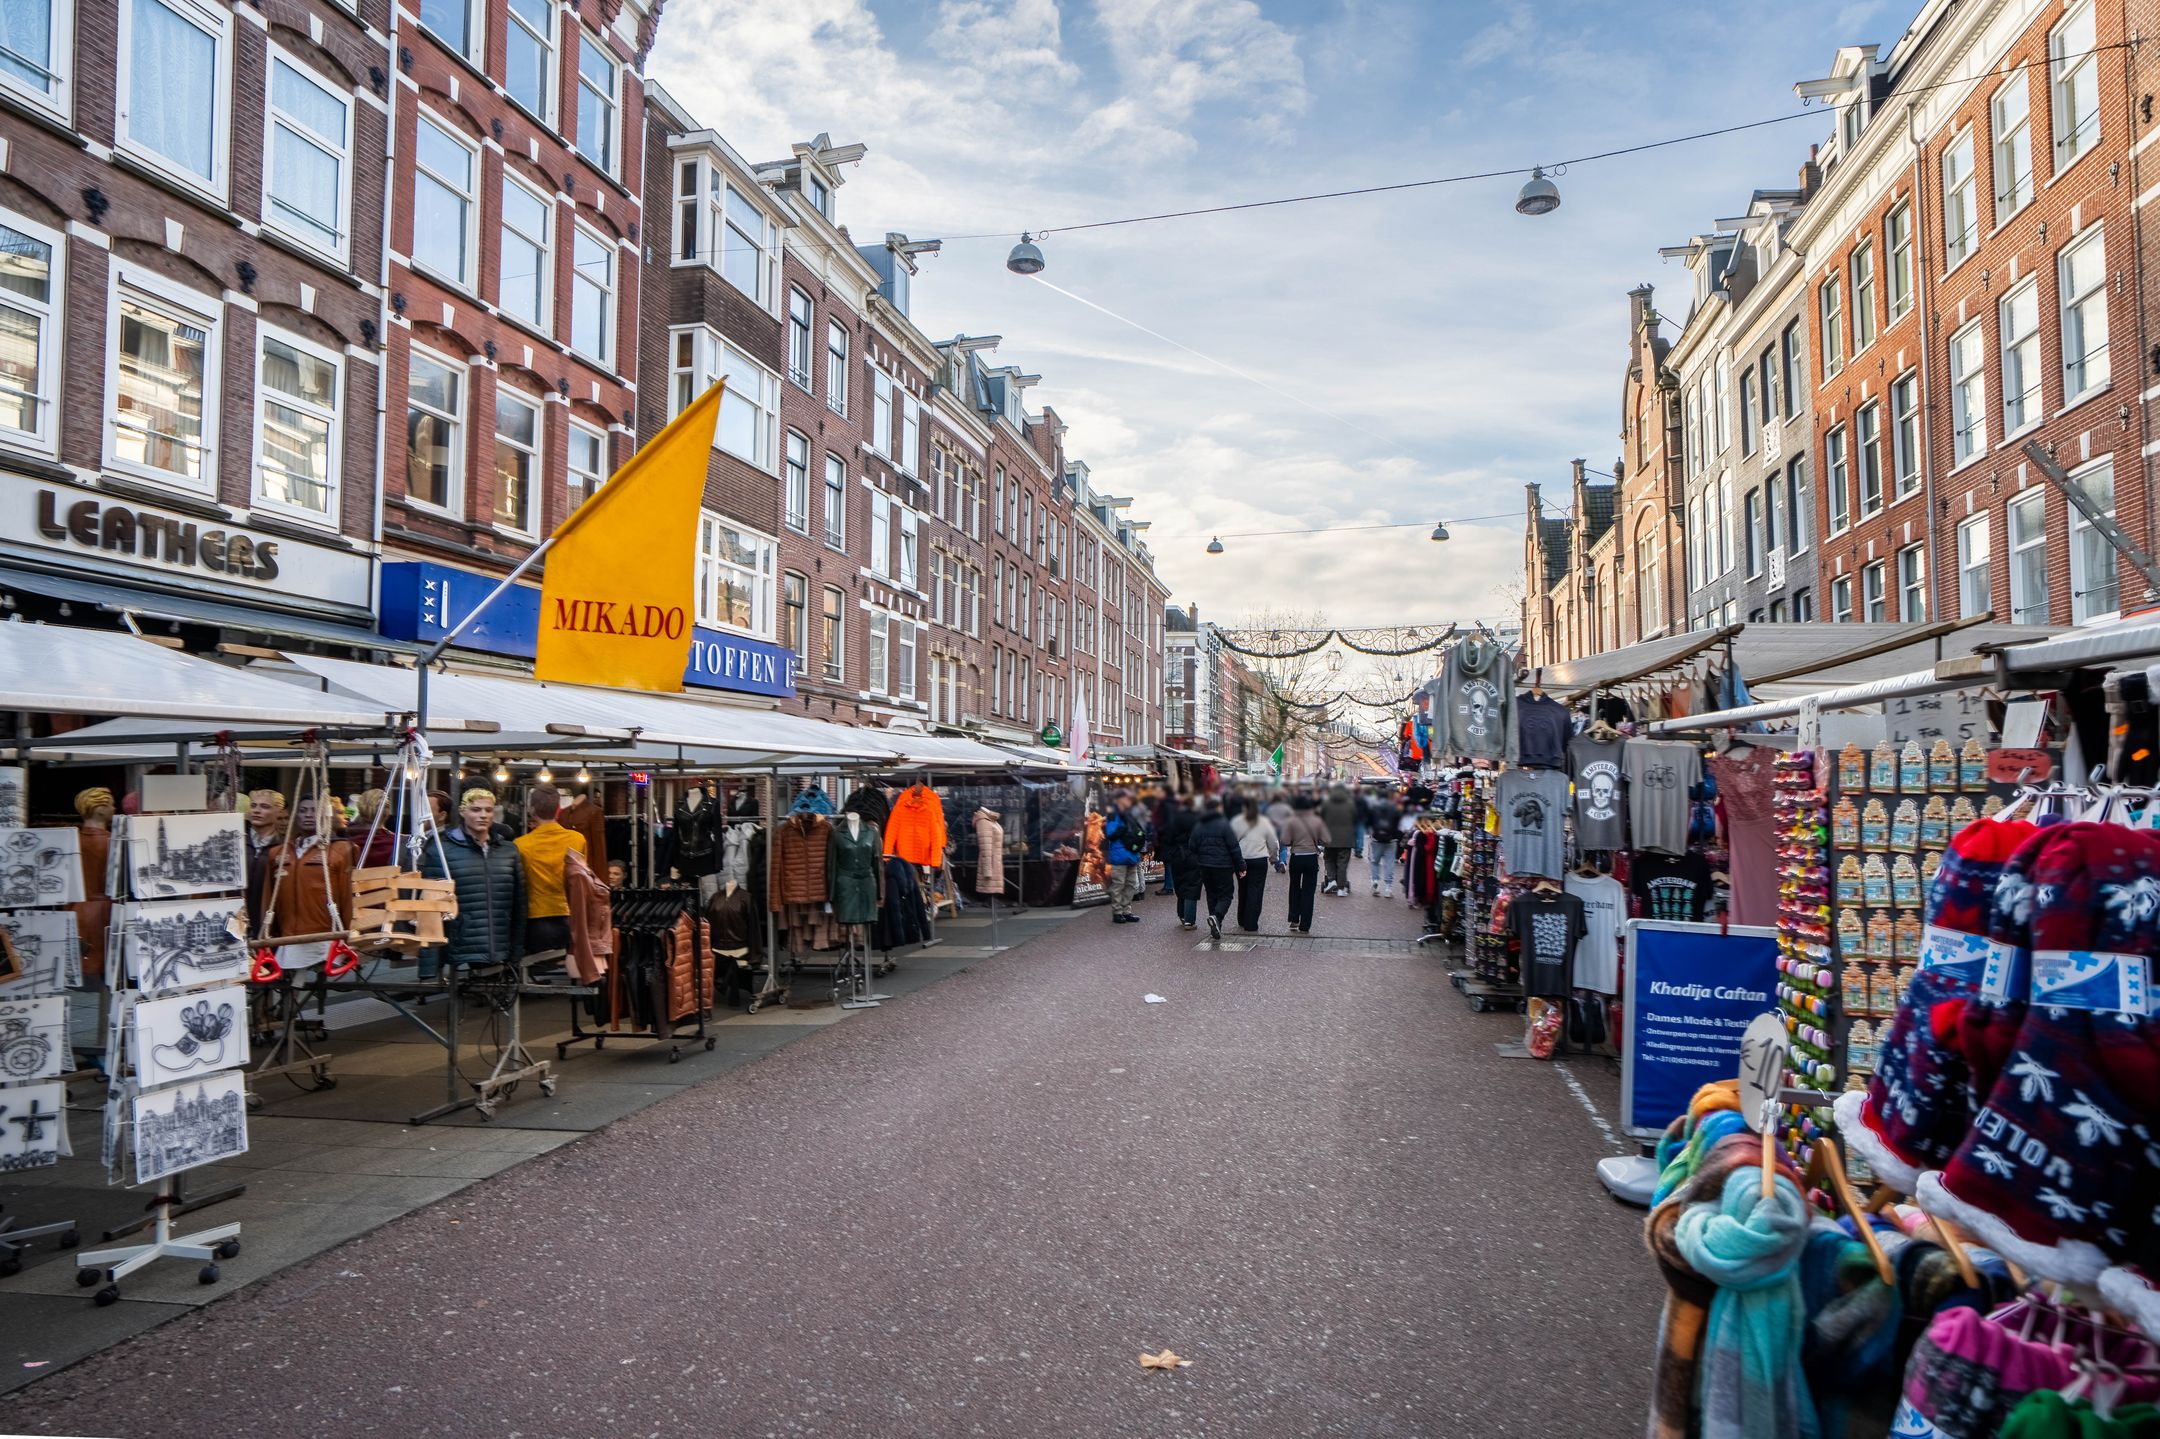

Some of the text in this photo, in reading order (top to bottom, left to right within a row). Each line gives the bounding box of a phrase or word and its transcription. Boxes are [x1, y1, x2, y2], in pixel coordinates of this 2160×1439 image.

[38, 489, 280, 580] LEATHERS
[553, 598, 685, 640] MIKADO
[693, 640, 776, 684] TOFFEN
[1916, 699, 1942, 710] FOR
[1917, 727, 1943, 738] FOR
[1585, 762, 1619, 778] AMSTERDA
[1076, 882, 1103, 894] hicken
[1647, 876, 1697, 890] AMSTERDAM
[1650, 981, 1768, 1002] Khadija Caftan
[1646, 1012, 1750, 1029] Dames Mode & Textil
